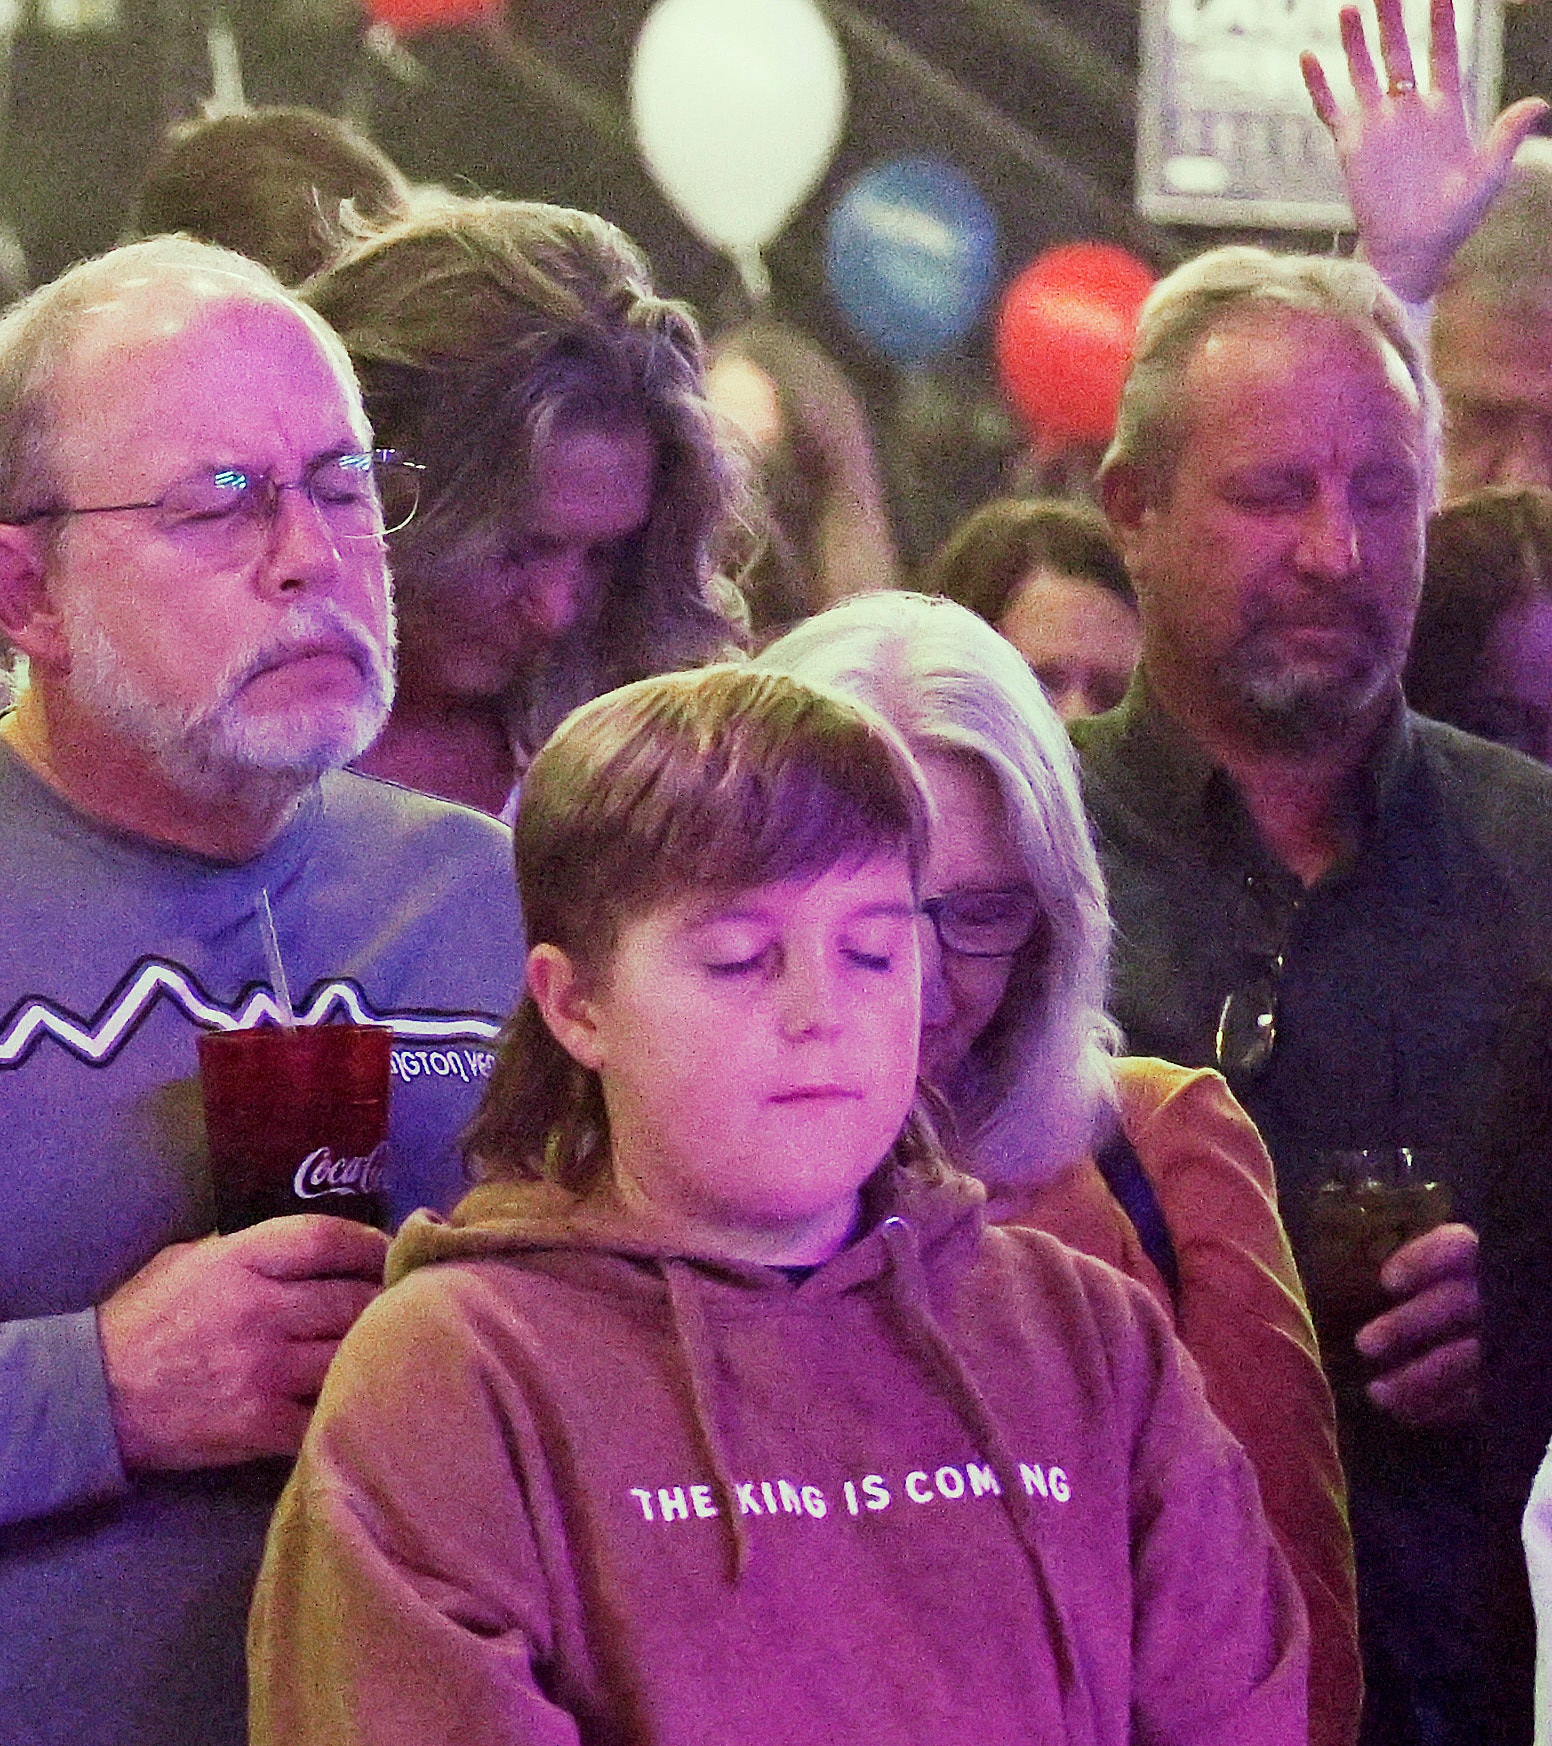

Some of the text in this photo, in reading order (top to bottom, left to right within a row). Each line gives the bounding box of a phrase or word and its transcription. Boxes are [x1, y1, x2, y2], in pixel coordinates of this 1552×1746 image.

[630, 1462, 1072, 1522] THE KING IS COMNG
